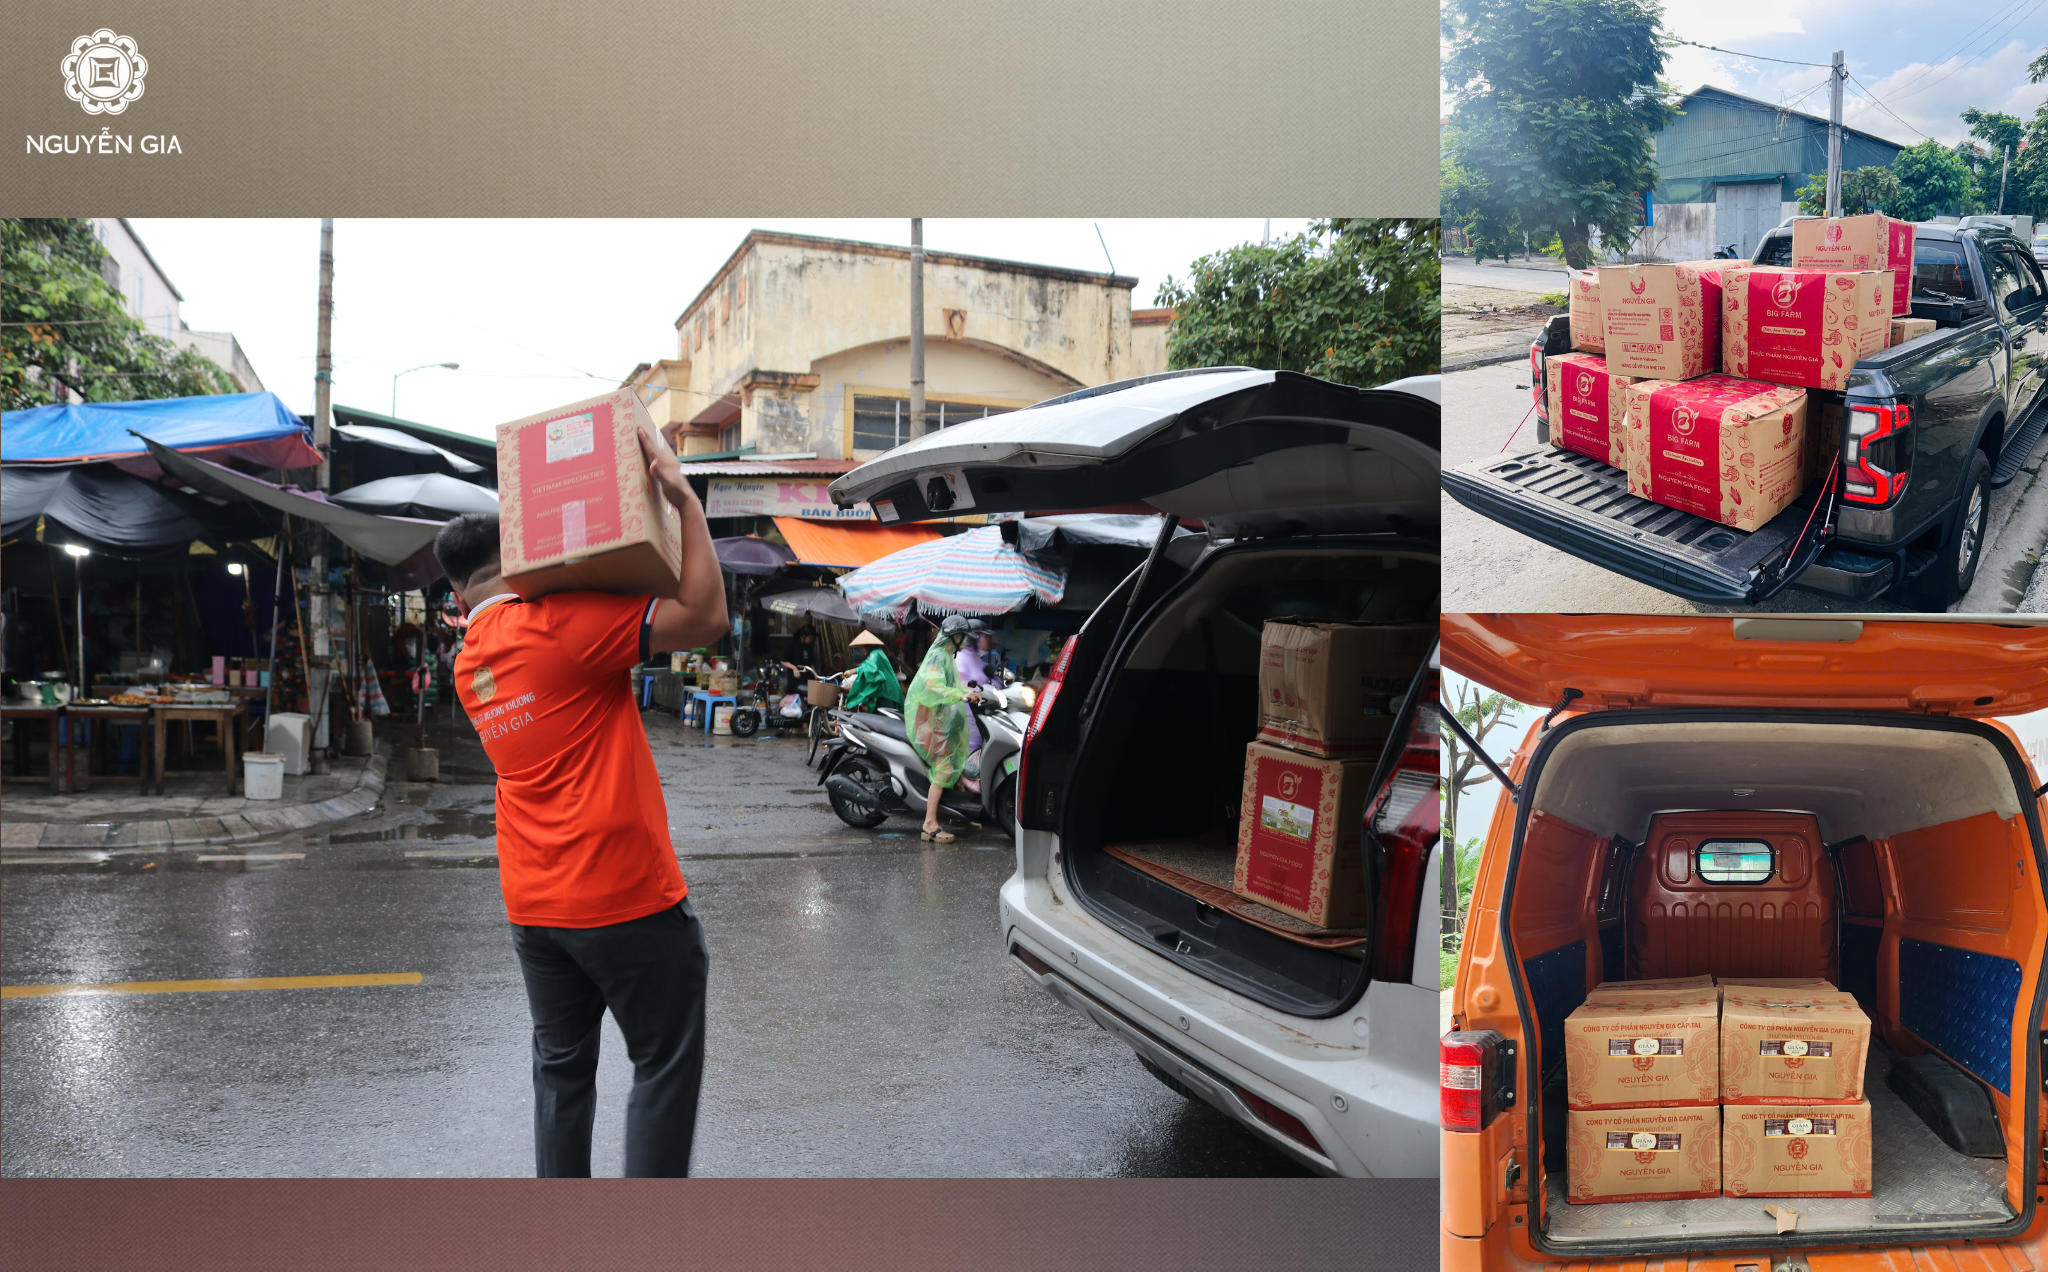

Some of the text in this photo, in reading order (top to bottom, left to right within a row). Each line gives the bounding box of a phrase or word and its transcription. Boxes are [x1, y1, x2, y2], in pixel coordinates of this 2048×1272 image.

[1766, 310, 1779, 318] BIG
[1668, 434, 1700, 448] BIG FARM
[1658, 474, 1682, 485] NGUYEN
[1694, 484, 1711, 494] FOOD
[802, 508, 832, 517] BÁN
[510, 712, 534, 731] GIA
[1288, 860, 1302, 868] FOOD
[1583, 1024, 1600, 1032] CÔNG
[1639, 1022, 1664, 1030] NGUYỄN
[1793, 1024, 1818, 1033] NGUYỄN
[1618, 1074, 1654, 1084] NGUYỄN
[1768, 1071, 1802, 1080] NGUYỄN
[1641, 1115, 1666, 1123] NGUYỄN
[1620, 1166, 1655, 1176] NGUYỄN
[1773, 1162, 1807, 1171] NGUYỄN
